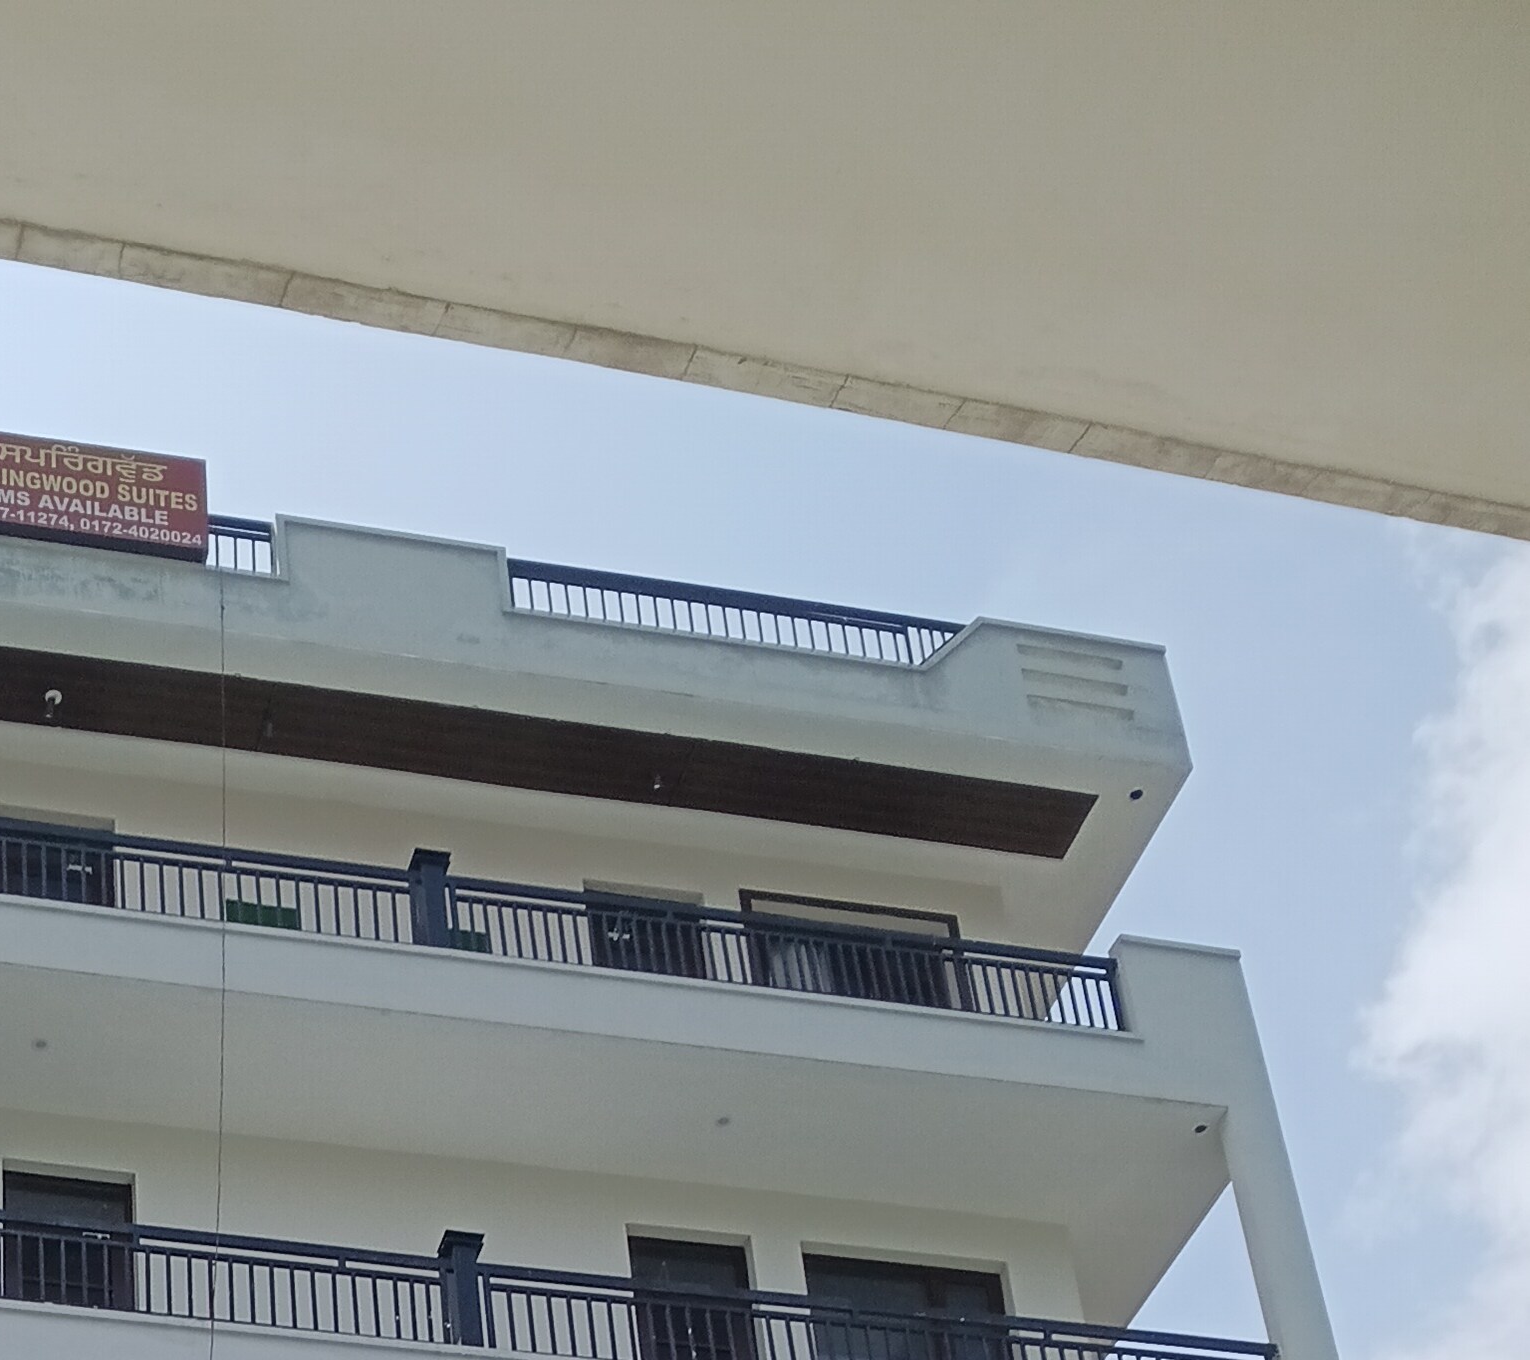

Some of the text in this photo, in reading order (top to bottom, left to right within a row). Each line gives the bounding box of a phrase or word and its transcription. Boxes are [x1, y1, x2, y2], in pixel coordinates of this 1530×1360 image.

[38, 494, 169, 526] AVAILABLE
[117, 483, 198, 512] SUITES
[80, 518, 202, 545] 0172-4020024
